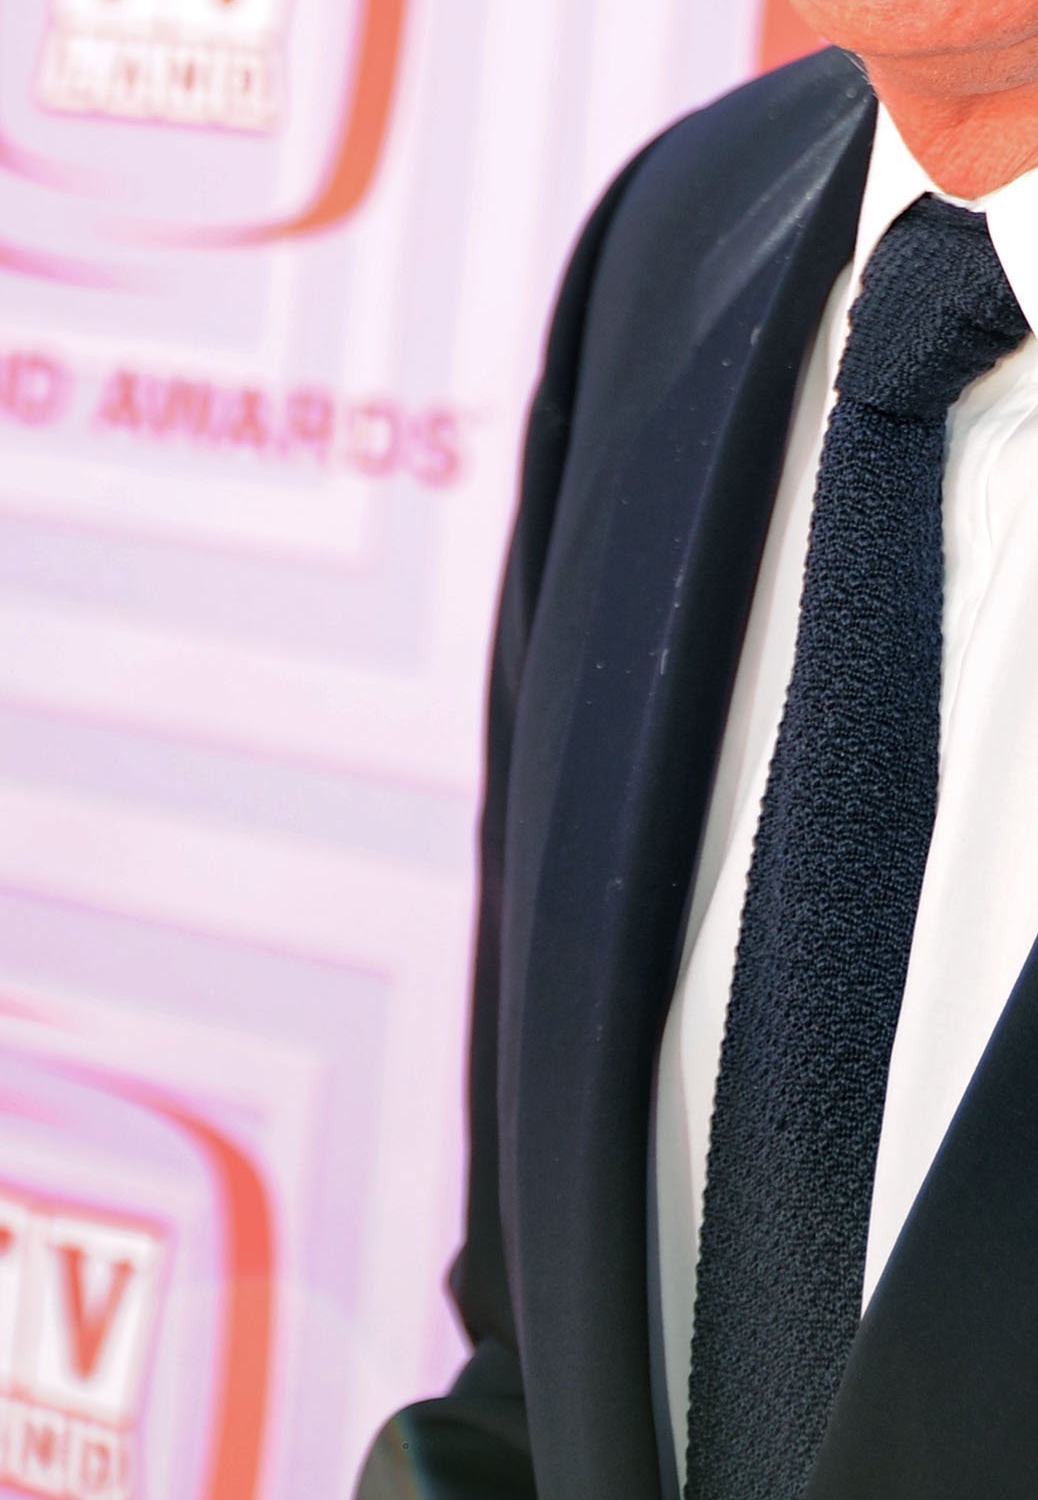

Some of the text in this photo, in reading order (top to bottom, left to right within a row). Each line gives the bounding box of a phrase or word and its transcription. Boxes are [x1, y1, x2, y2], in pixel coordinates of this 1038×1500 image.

[0, 350, 464, 488] D AWARDS
[0, 1226, 136, 1382] V
